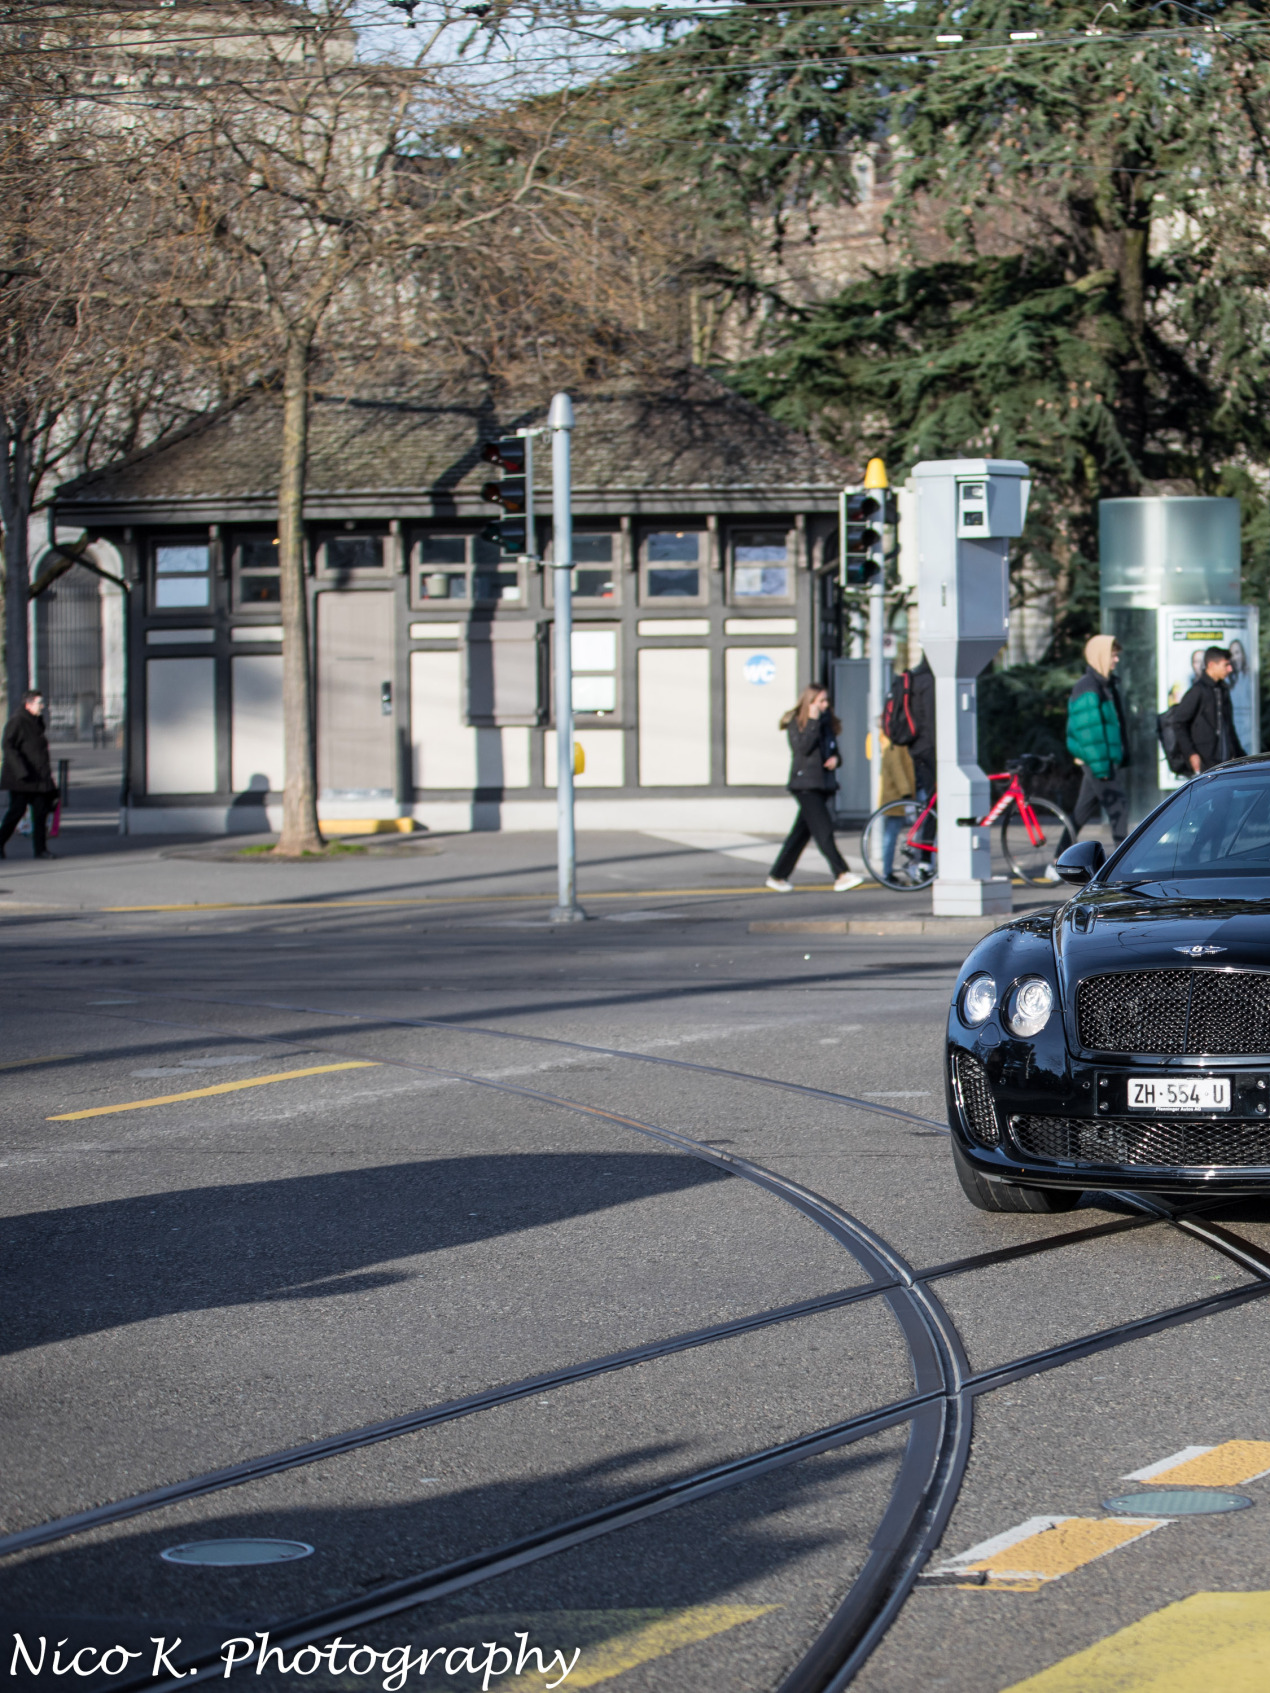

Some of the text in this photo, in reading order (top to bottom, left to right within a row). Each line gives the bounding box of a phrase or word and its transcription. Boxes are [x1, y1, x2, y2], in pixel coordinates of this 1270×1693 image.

[743, 660, 776, 682] WC
[1167, 1083, 1200, 1104] 554
[1213, 1084, 1224, 1104] U
